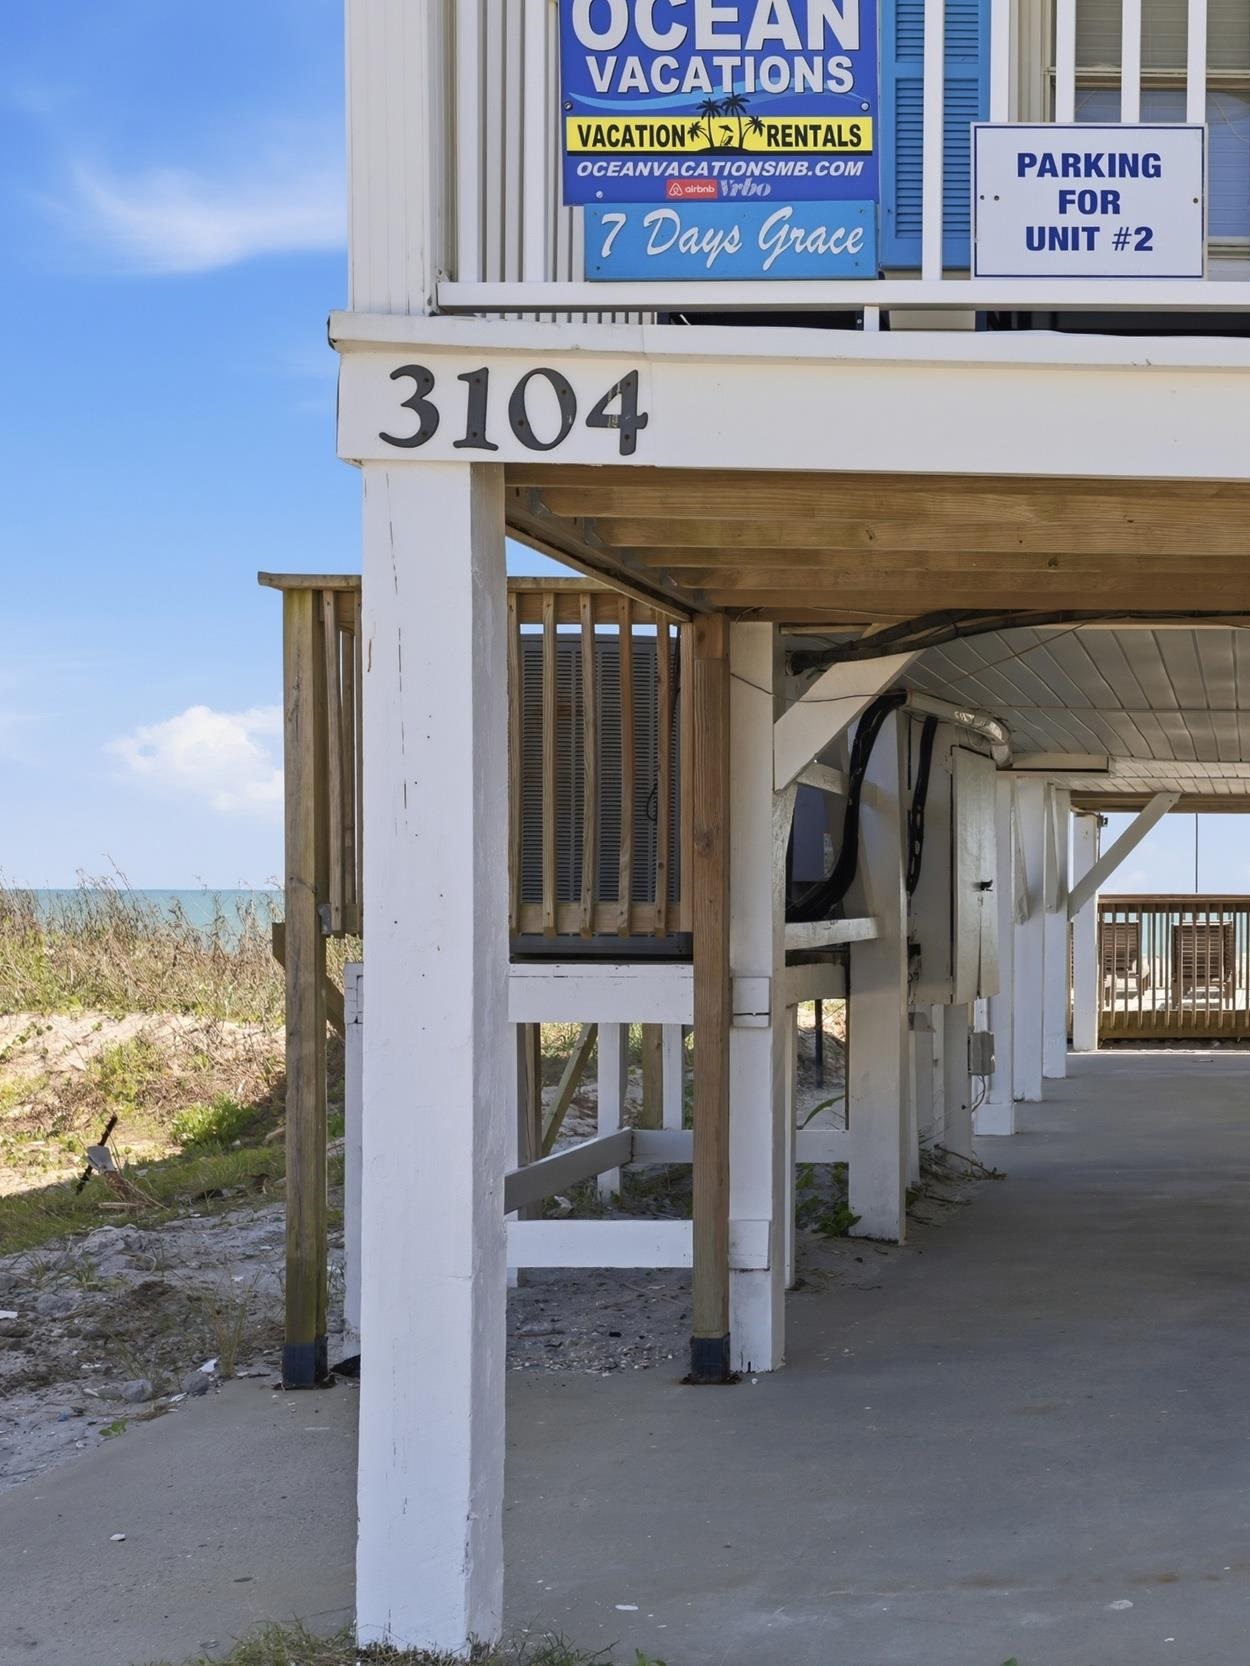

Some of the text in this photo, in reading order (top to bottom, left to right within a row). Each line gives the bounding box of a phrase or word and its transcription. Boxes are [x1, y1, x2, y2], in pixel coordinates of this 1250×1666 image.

[585, 55, 855, 94] VACATIONS
[577, 123, 862, 148] VACATION RENTALS
[576, 160, 864, 178] OCEANVACATIONSMB.COM
[1017, 152, 1162, 179] PARKING
[684, 177, 772, 198] airbnb Vrbo
[1058, 189, 1121, 215] FOR
[600, 205, 865, 272] 7 Days Grace
[1025, 226, 1154, 252] UNIT #2
[378, 363, 649, 456] 3104
